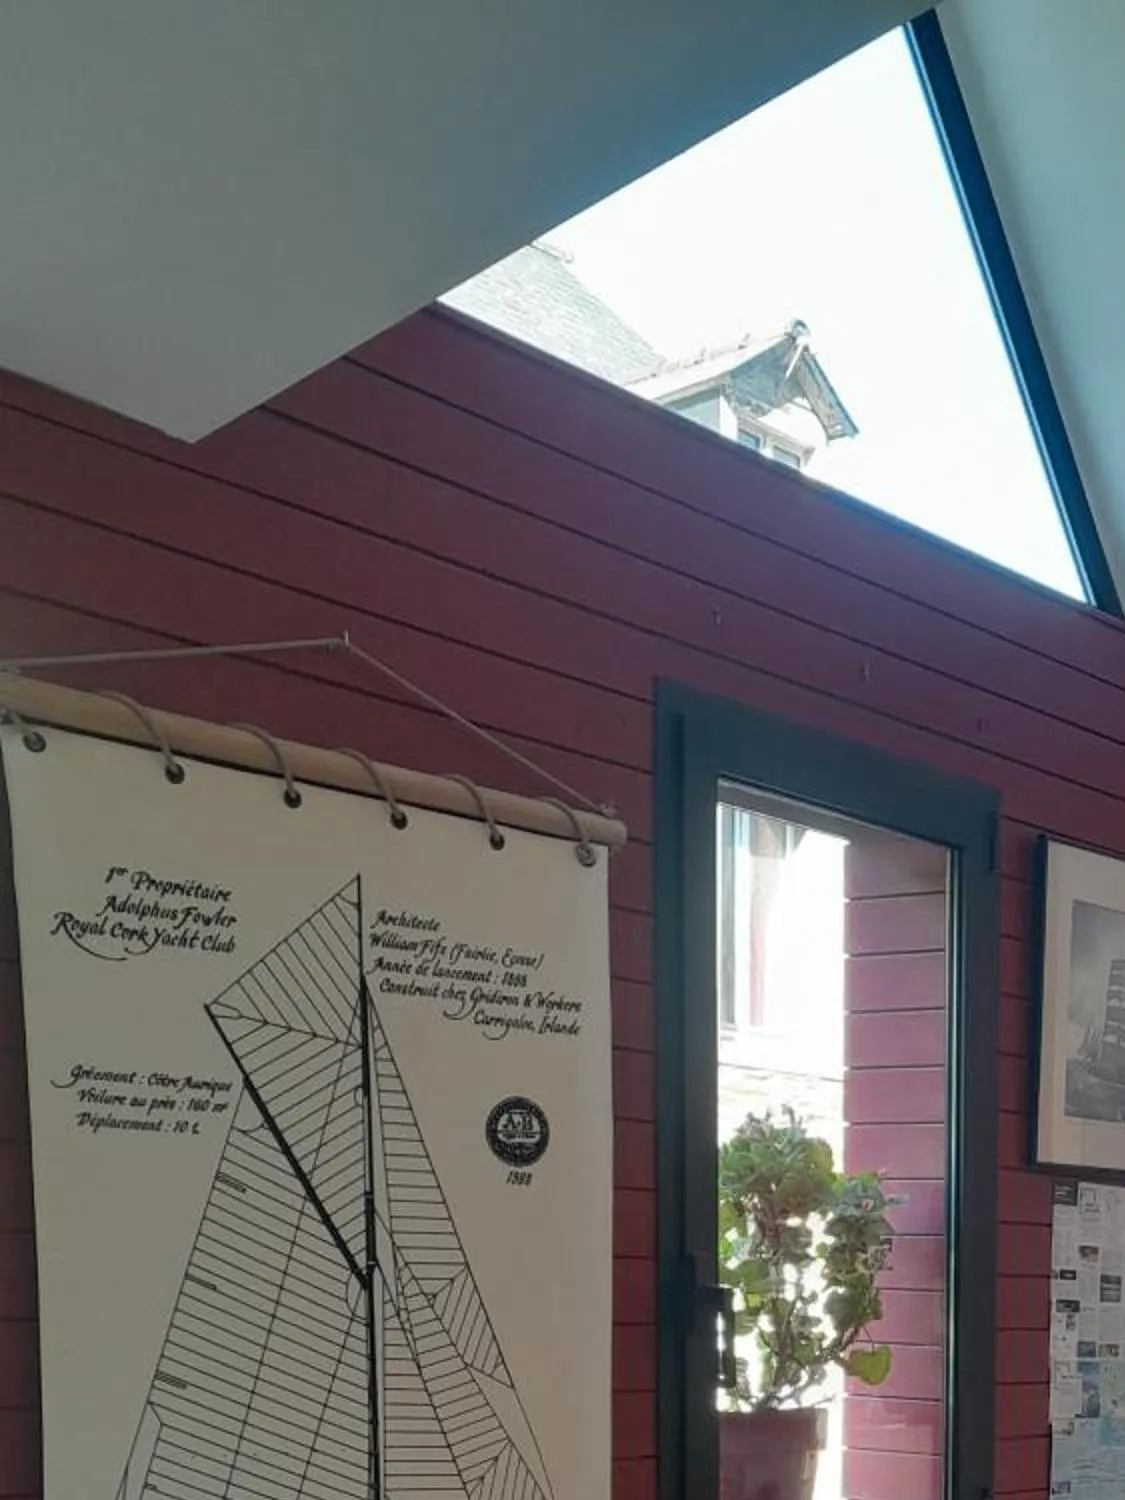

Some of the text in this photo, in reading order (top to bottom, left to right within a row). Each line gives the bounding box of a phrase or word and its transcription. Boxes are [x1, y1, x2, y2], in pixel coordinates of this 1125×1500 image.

[96, 894, 237, 930] Adolphus Fowler
[369, 909, 441, 932] Architecte
[50, 911, 236, 954] Royal Cork Yacht Club
[369, 929, 419, 951] William
[414, 958, 432, 976] de
[432, 960, 492, 984] lancement
[379, 978, 439, 1000] Construit
[441, 983, 467, 1013] chez
[58, 1064, 137, 1087] Gréement
[129, 1096, 147, 1108] au
[76, 1111, 164, 1134] Déplacement
